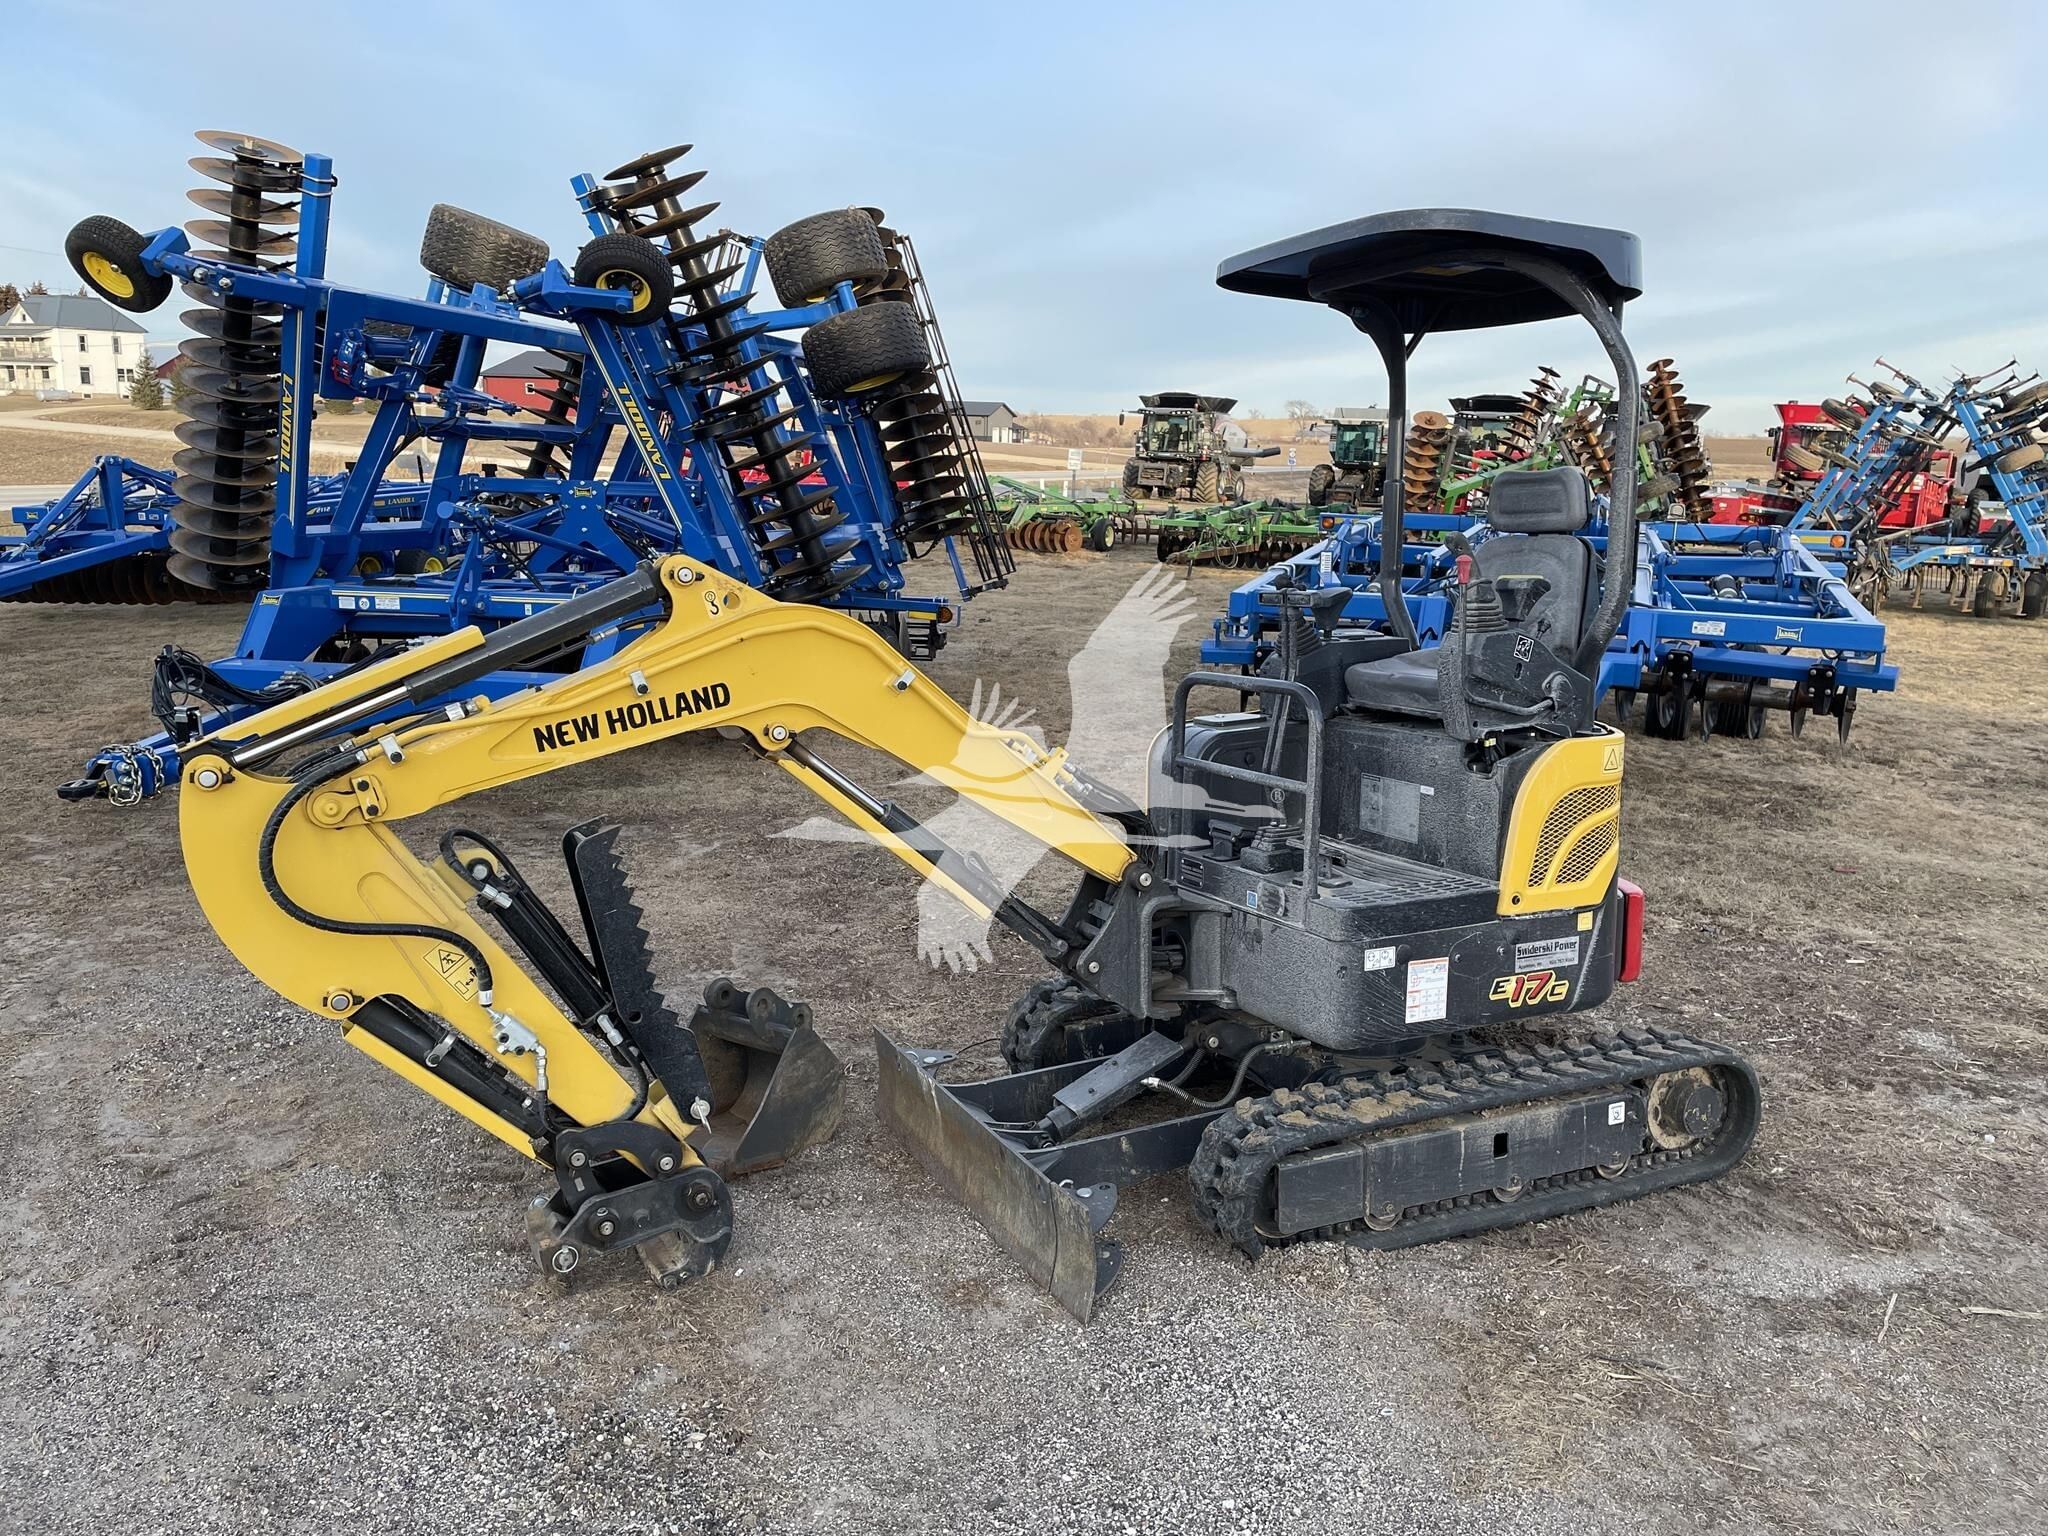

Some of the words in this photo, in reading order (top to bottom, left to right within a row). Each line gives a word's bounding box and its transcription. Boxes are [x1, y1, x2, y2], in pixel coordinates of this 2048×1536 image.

[280, 373, 293, 473] LANDOLL
[618, 381, 672, 479] LANDOLL
[533, 713, 600, 752] NEW
[605, 682, 731, 735] HOLLAND
[1517, 942, 1553, 956] Swiderski
[1554, 940, 1577, 952] Power
